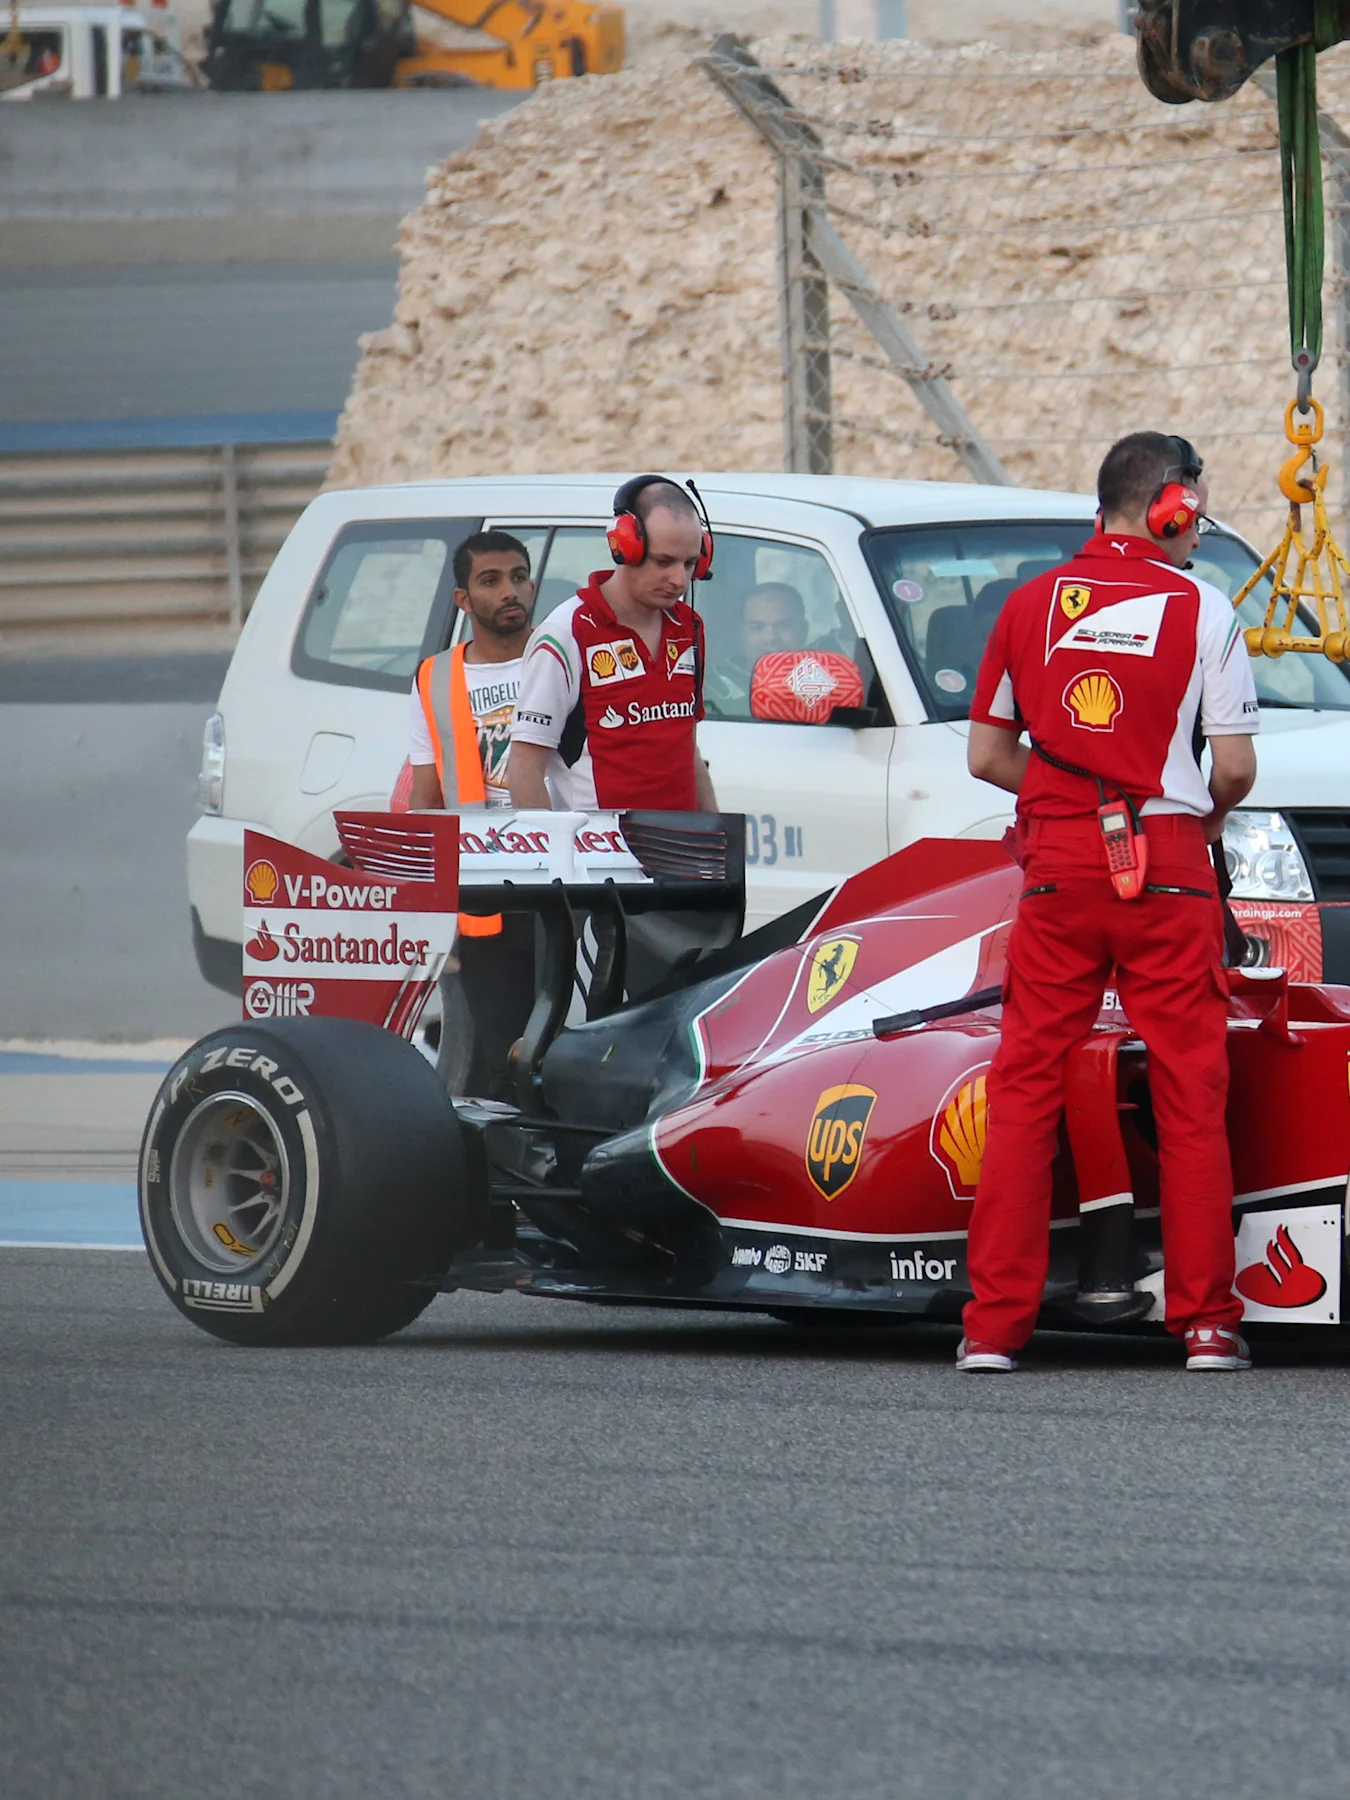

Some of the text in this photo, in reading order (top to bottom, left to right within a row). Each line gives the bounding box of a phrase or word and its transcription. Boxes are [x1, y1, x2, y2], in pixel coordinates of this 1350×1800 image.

[618, 651, 639, 668] ups
[283, 874, 397, 909] V-Power
[283, 921, 430, 966] Santander
[200, 1046, 306, 1106] ZERO
[809, 1118, 864, 1182] ups
[794, 1251, 828, 1273] SKF
[889, 1249, 958, 1281] infor
[182, 1277, 265, 1313] PIRELLI
